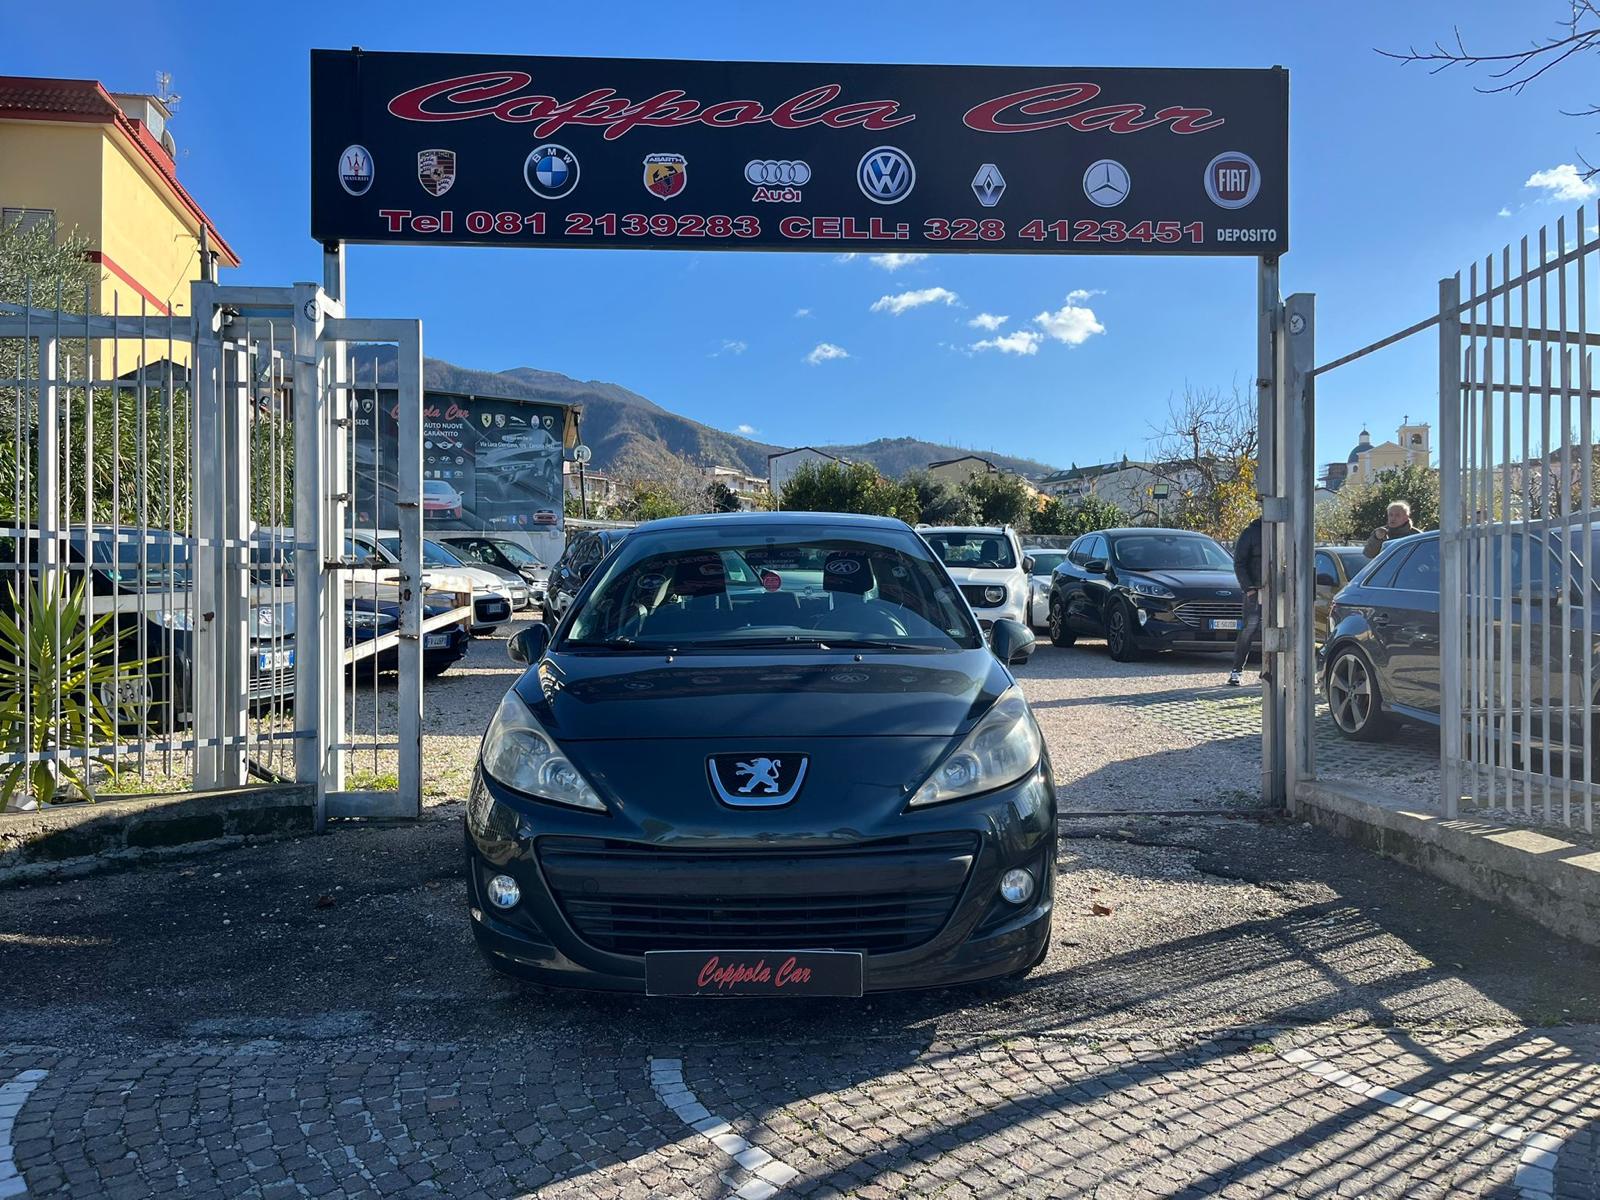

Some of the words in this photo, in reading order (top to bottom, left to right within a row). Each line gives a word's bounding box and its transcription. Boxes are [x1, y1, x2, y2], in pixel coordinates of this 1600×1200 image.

[388, 71, 916, 140] Coppola
[962, 82, 1225, 135] Car
[531, 148, 573, 164] BMW
[1218, 168, 1248, 192] FIAT
[752, 187, 802, 203] Audi
[379, 209, 454, 233] Tel
[466, 211, 547, 235] 081
[565, 213, 762, 237] 2139283
[779, 216, 911, 240] CELL:
[923, 219, 1006, 241] 328
[1018, 219, 1205, 243] 4123451
[1216, 228, 1278, 242] DEPOSITO
[697, 956, 772, 990] Coppola
[774, 956, 813, 988] Car
